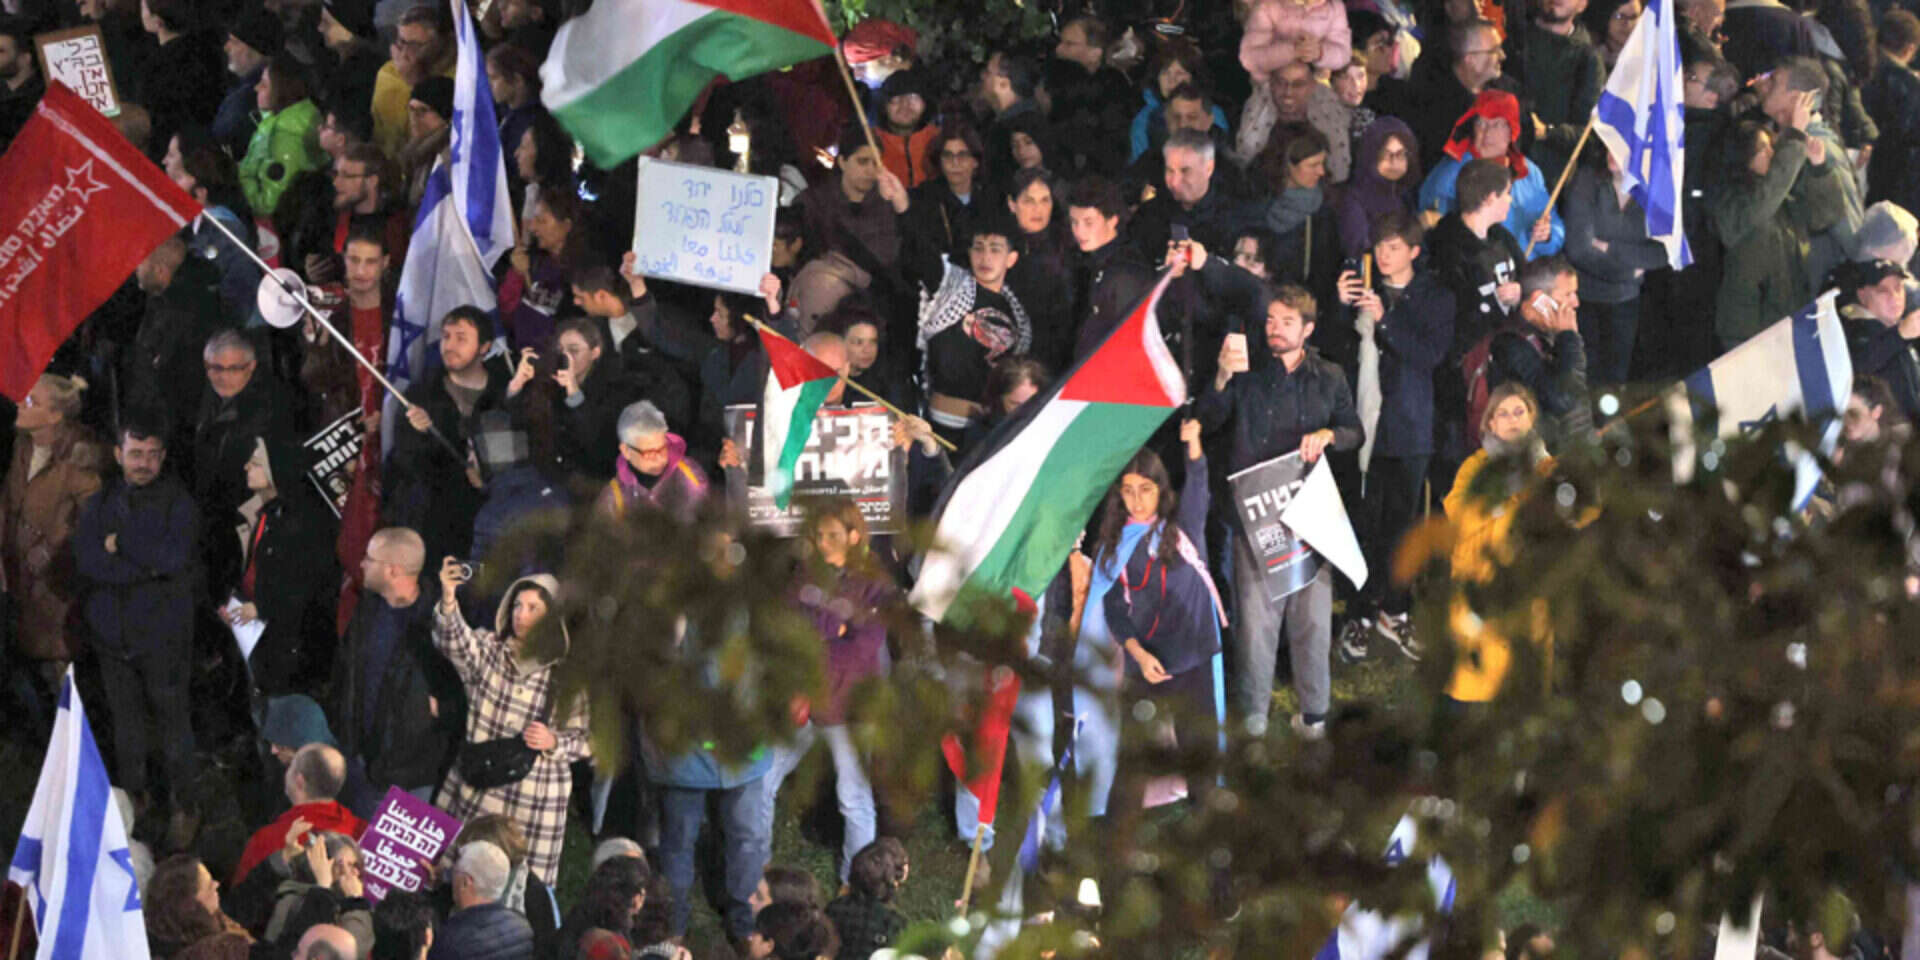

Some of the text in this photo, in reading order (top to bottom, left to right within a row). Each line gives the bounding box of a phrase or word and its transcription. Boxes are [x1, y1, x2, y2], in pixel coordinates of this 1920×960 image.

[683, 179, 711, 199] יחד
[18, 184, 65, 238] מאבק
[313, 421, 355, 453] דיור
[380, 818, 437, 855] זה הבית
[387, 799, 445, 842] هذا بيتنا
[395, 869, 418, 889] של
